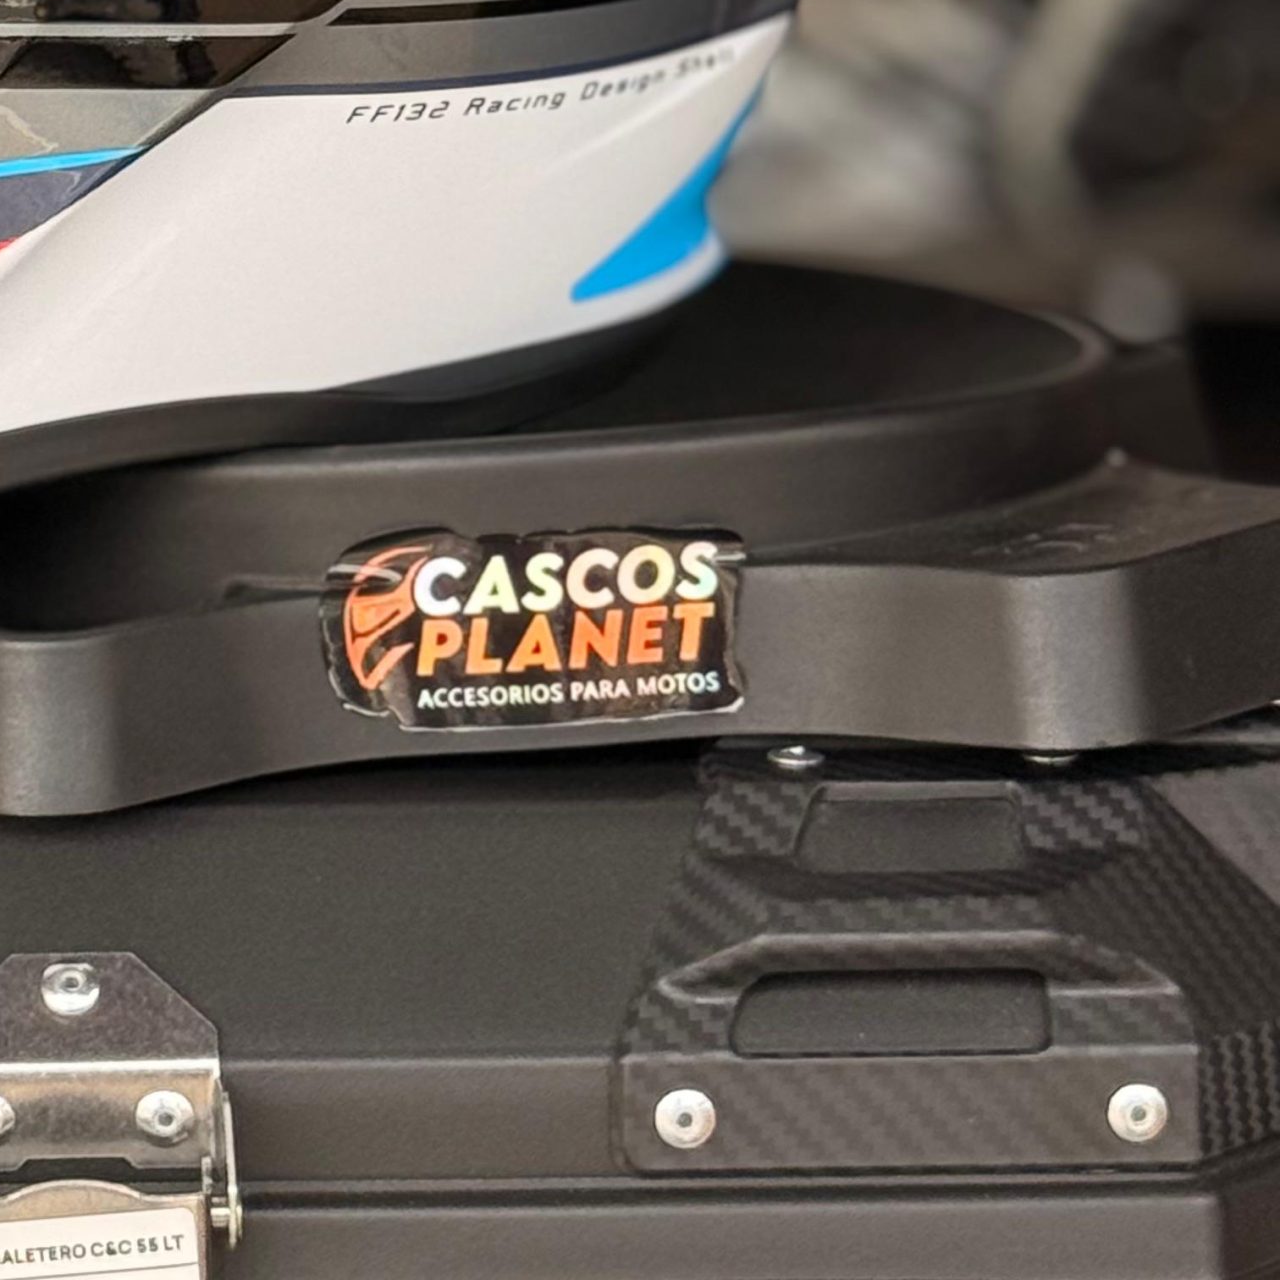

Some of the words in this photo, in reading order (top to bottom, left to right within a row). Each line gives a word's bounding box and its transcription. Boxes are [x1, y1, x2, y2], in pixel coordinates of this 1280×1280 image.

[346, 102, 450, 125] FF132
[463, 90, 566, 117] Racing
[580, 68, 667, 101] Design
[413, 540, 720, 617] CASCOS
[416, 601, 716, 677] PLANET
[418, 681, 565, 710] ACCESORIOS
[570, 677, 631, 702] PARA
[635, 670, 721, 697] MOTOS
[90, 1239, 133, 1258] C&C
[136, 1237, 159, 1254] 55
[162, 1234, 185, 1252] LT
